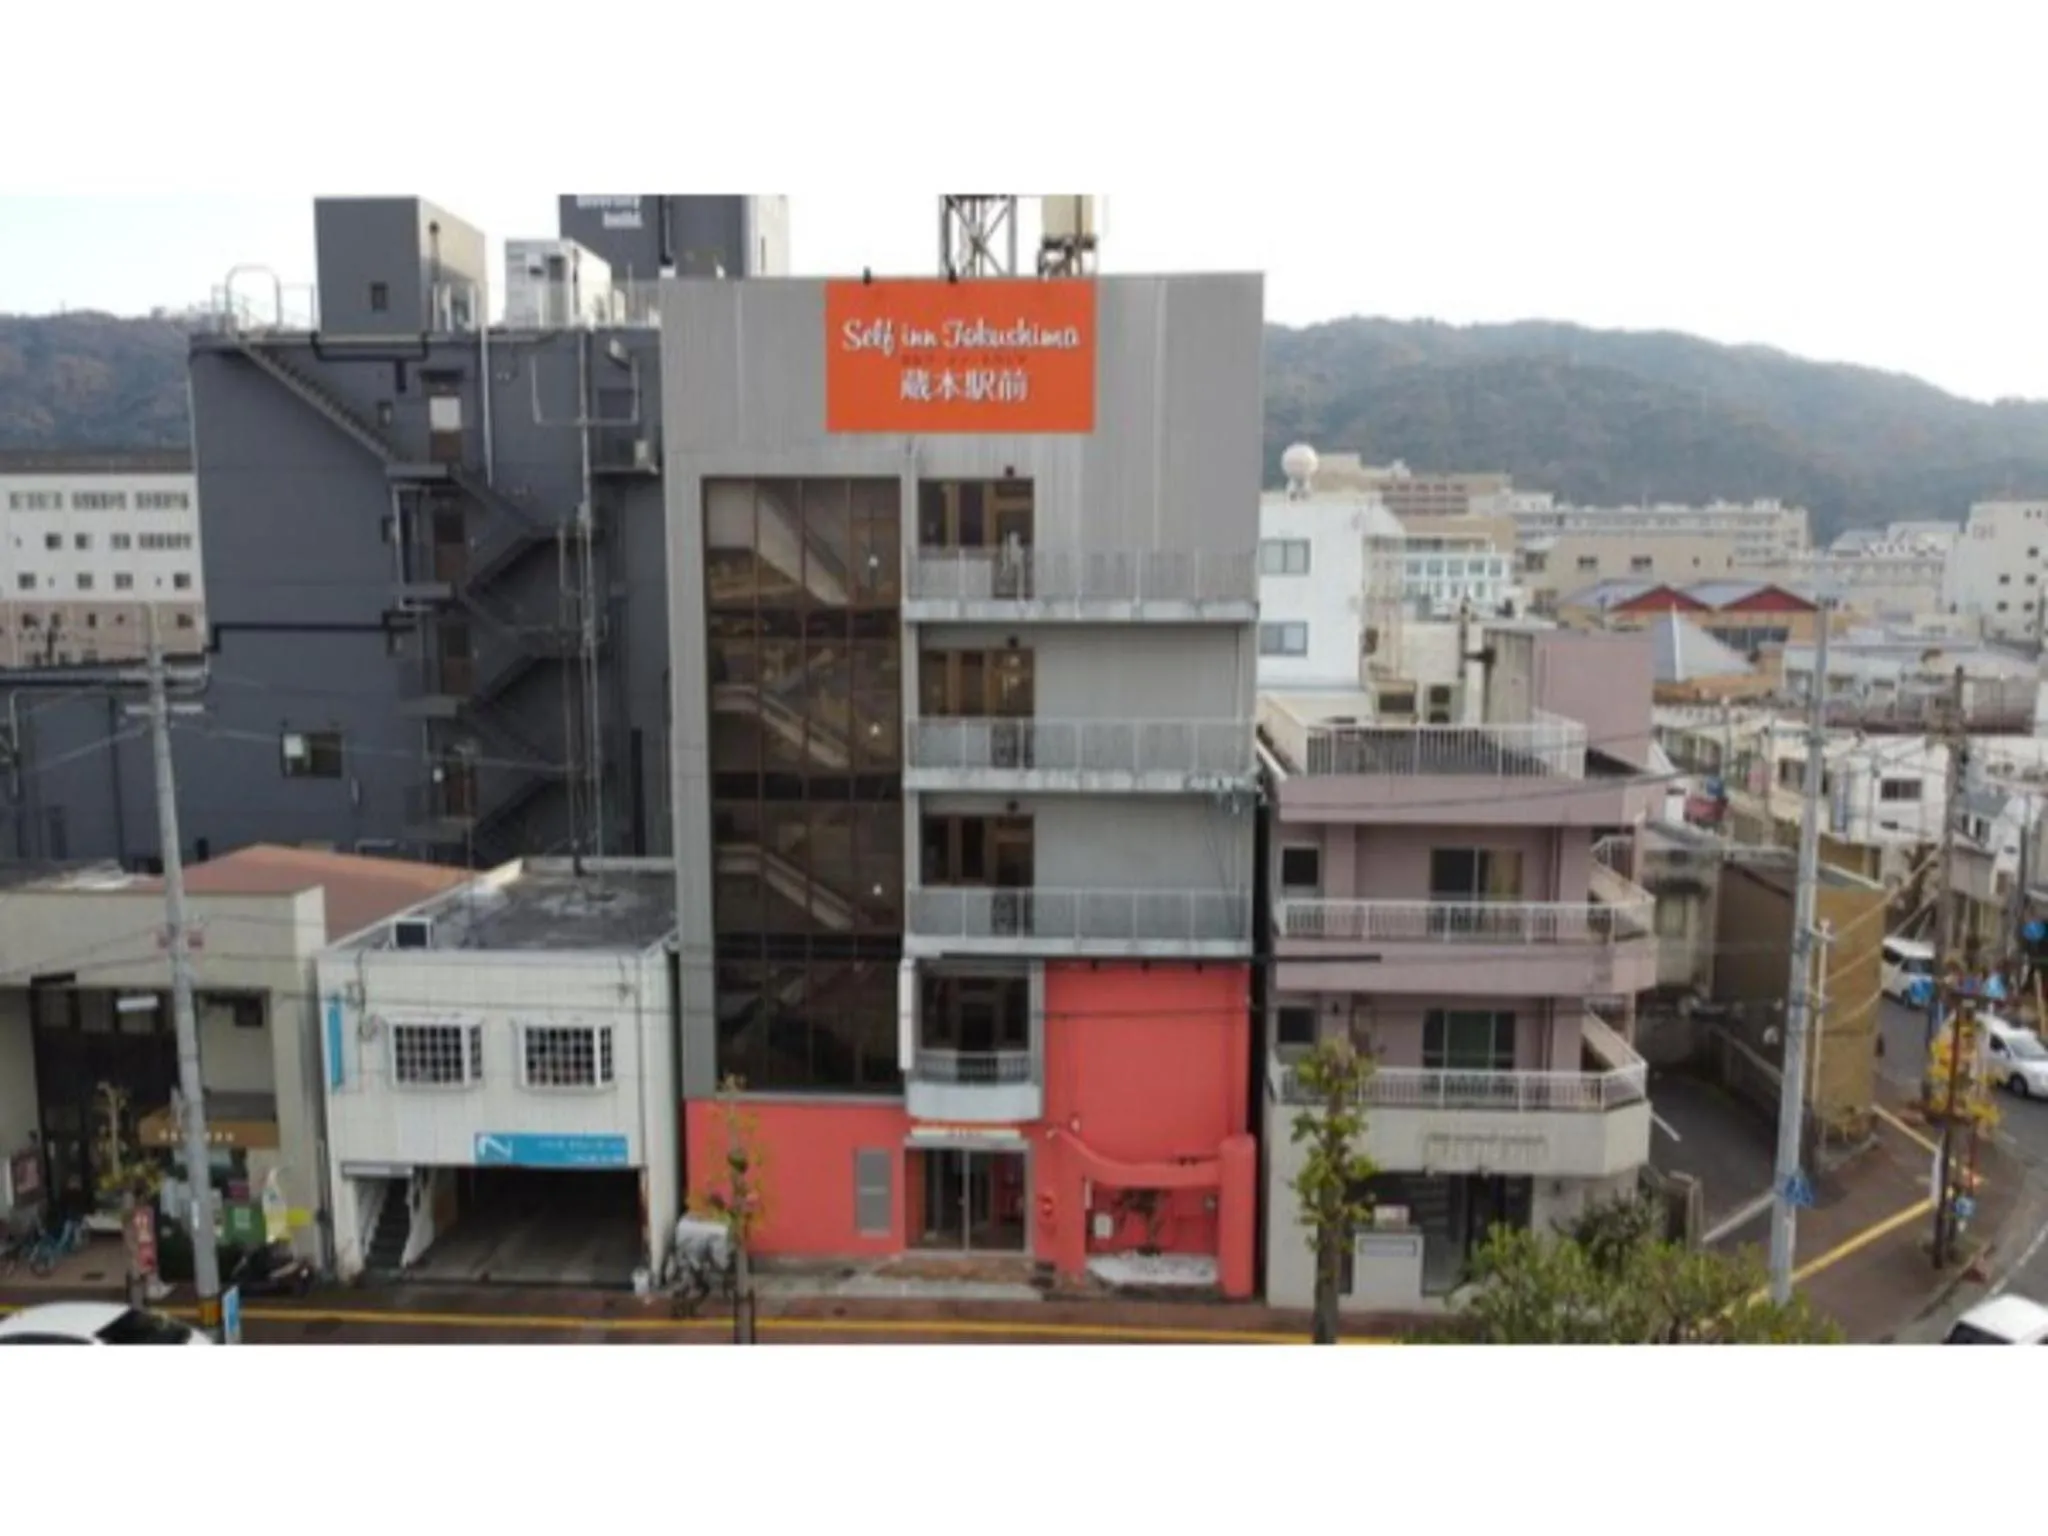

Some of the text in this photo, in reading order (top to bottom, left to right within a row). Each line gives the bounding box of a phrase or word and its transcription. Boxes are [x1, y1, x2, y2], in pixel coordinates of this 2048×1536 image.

[842, 316, 1080, 357] Self inn Tokushima
[900, 367, 1029, 402] 蔵本駅前
